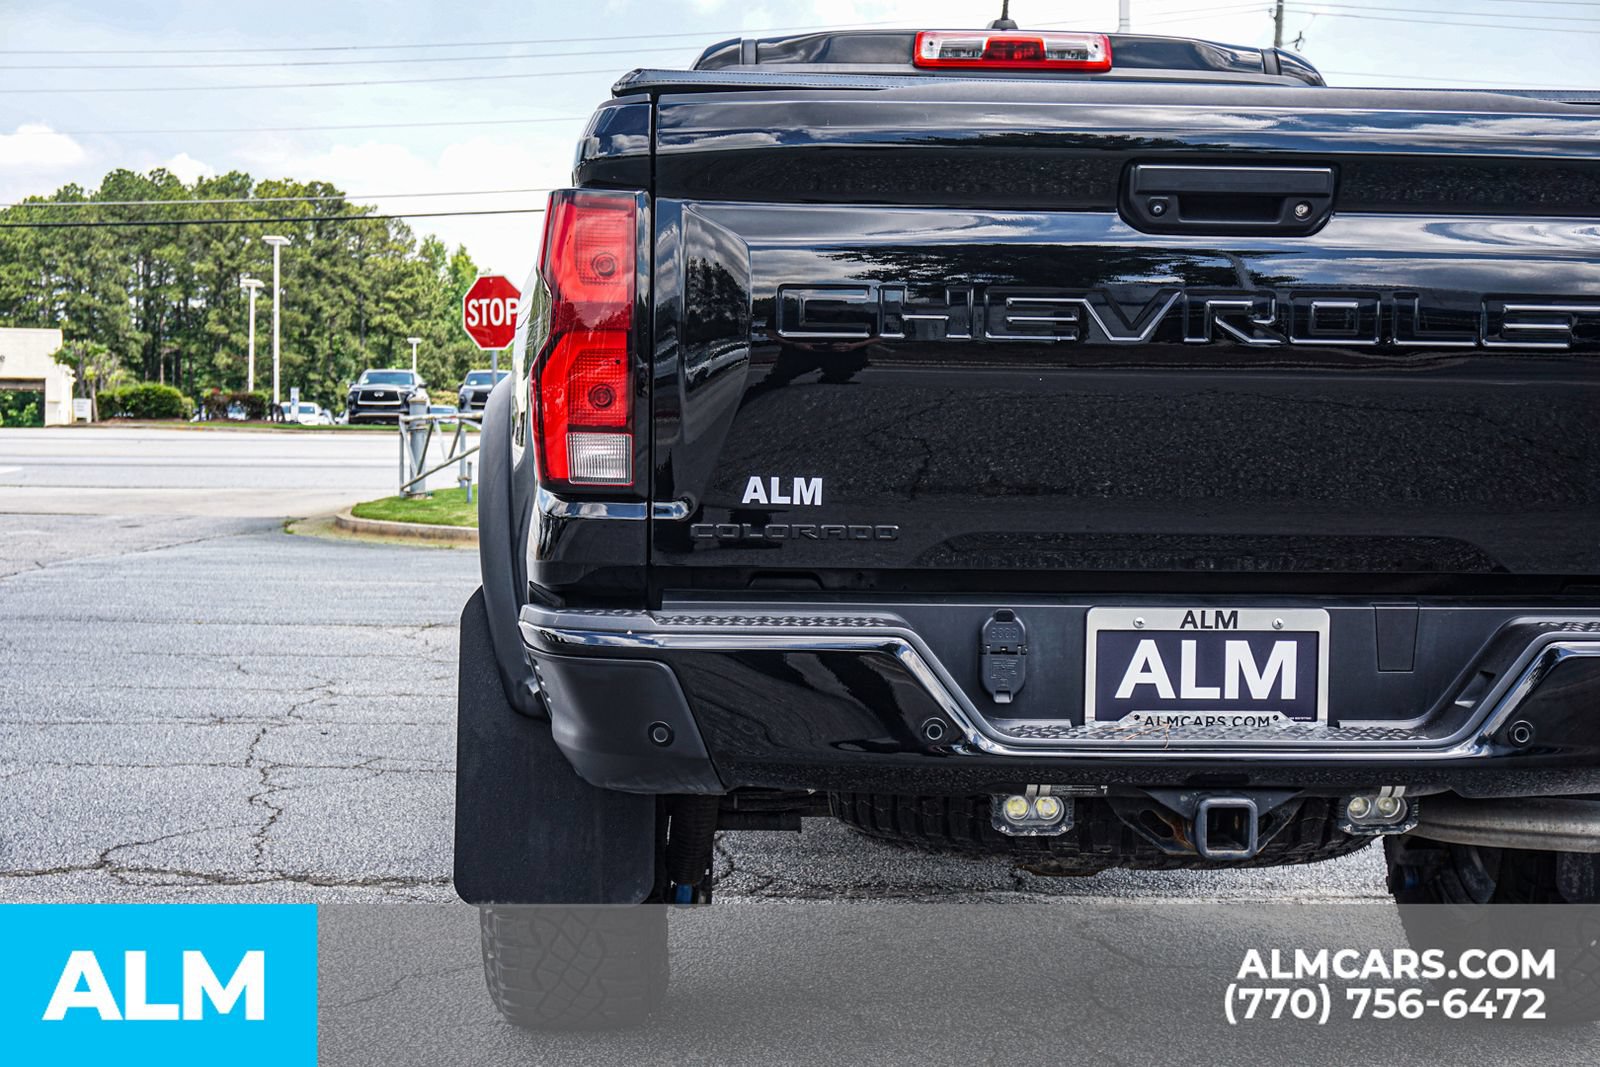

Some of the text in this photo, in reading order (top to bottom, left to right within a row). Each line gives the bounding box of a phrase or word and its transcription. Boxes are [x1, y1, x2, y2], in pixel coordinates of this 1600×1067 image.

[467, 297, 519, 327] STOP
[776, 283, 1600, 349] CHEVROLE
[742, 476, 823, 506] ALM
[690, 523, 899, 541] COLORADO
[1180, 610, 1239, 630] ALM
[1114, 639, 1298, 700] ALM
